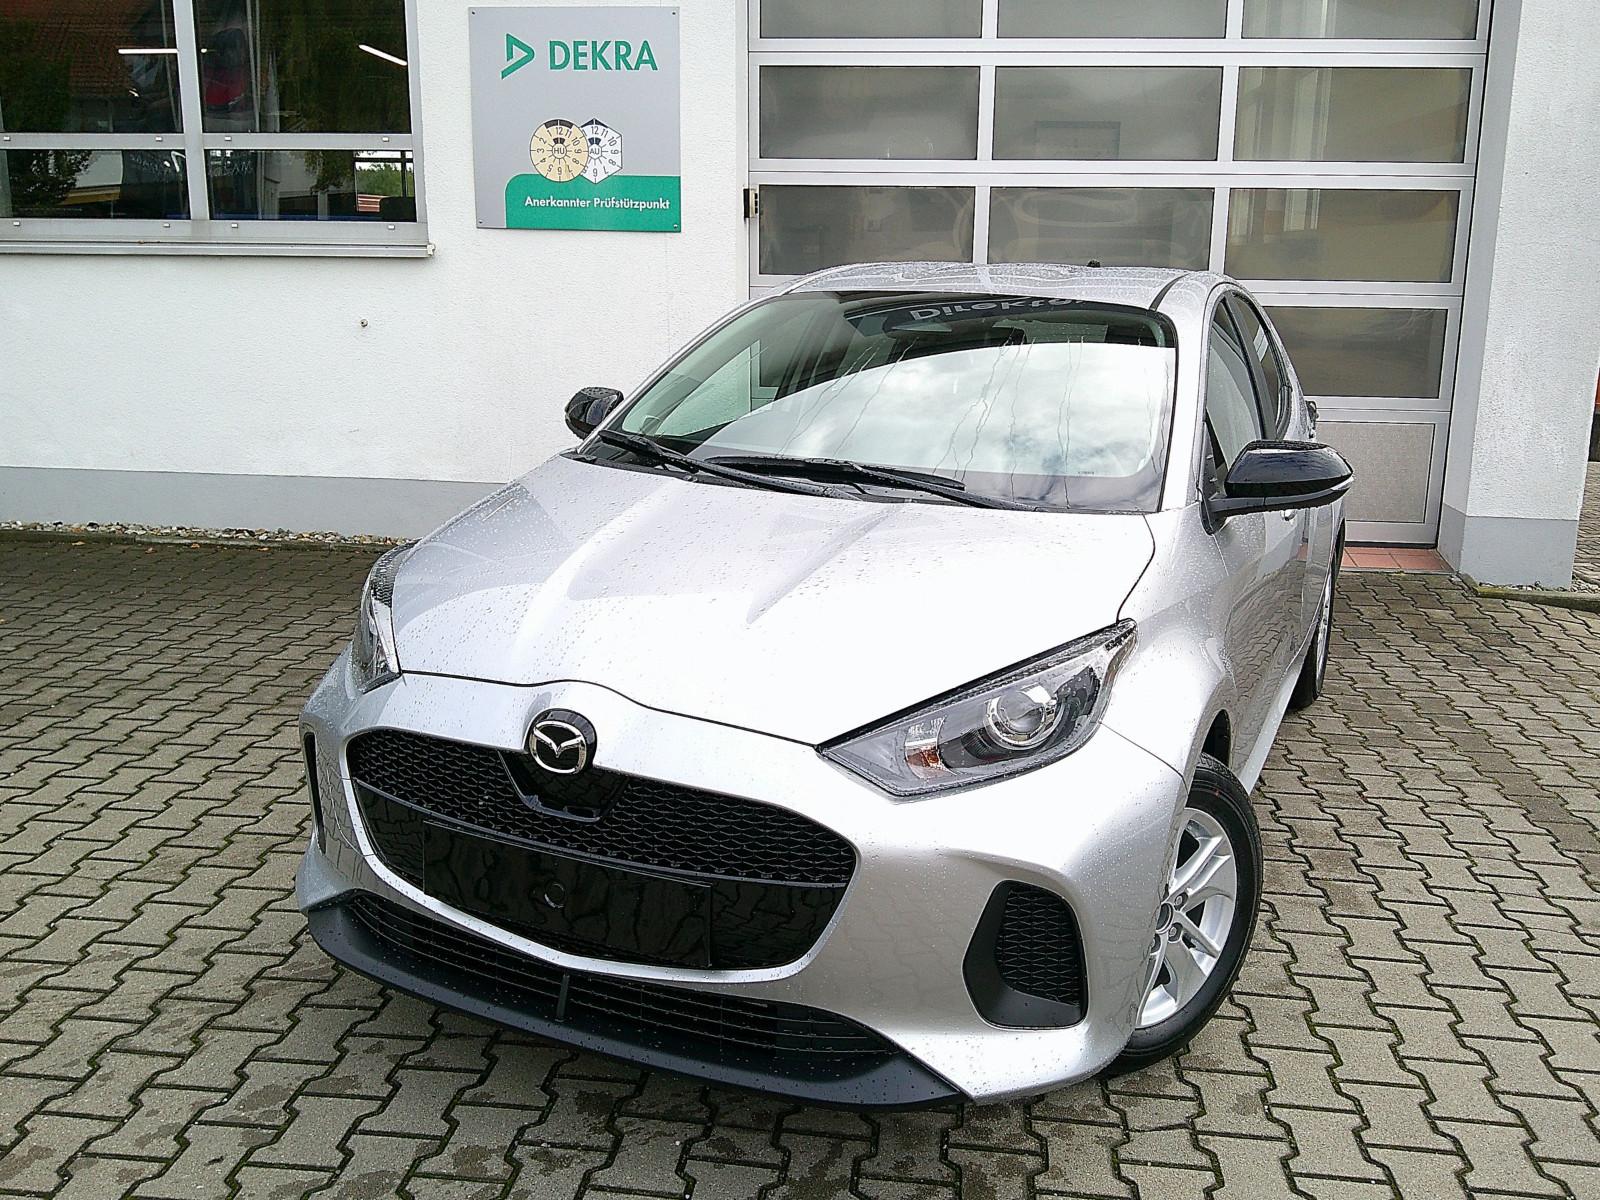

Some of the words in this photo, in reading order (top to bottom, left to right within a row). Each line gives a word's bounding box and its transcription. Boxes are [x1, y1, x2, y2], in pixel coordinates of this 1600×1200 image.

[549, 40, 658, 70] DEKRA
[555, 126, 563, 134] 12
[591, 126, 599, 134] 12
[601, 130, 609, 138] 11
[608, 137, 617, 146] 10
[525, 196, 591, 208] Anerkannter
[593, 197, 670, 211] Prüfstützpunkt
